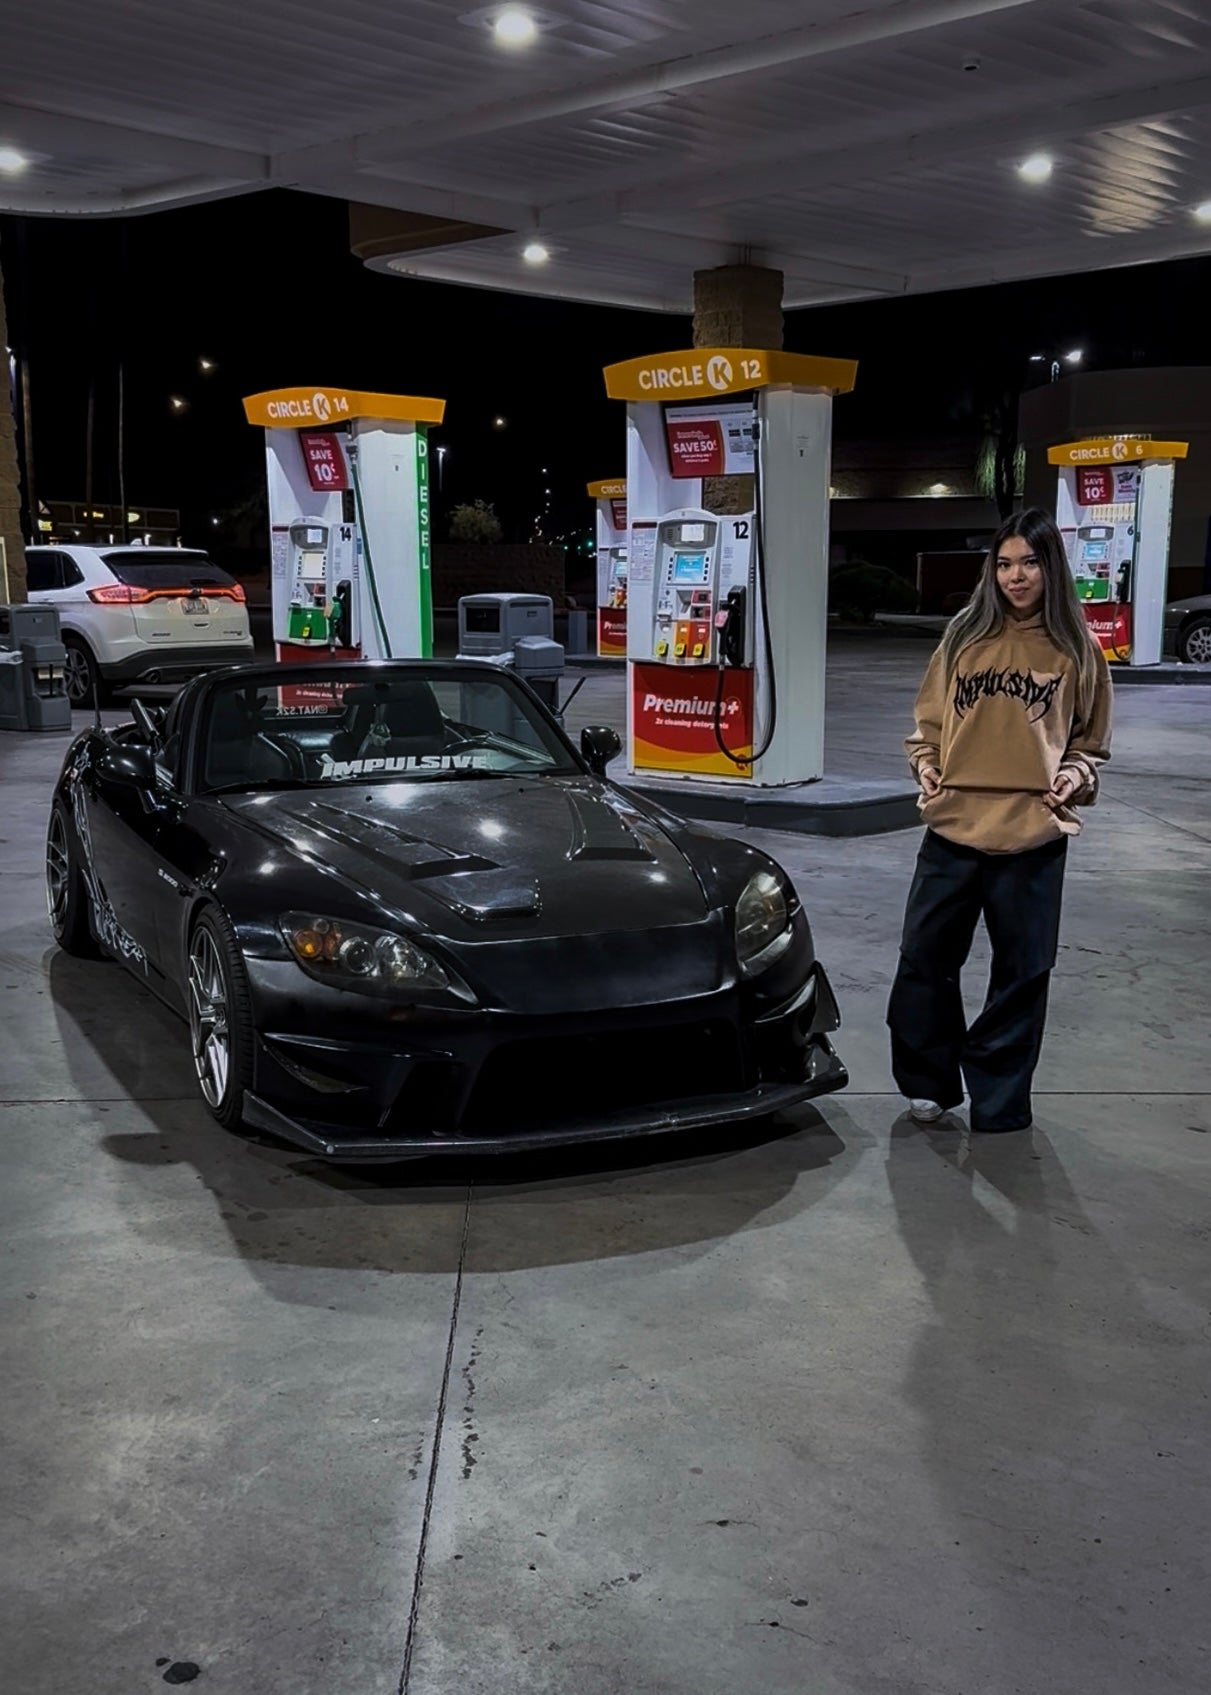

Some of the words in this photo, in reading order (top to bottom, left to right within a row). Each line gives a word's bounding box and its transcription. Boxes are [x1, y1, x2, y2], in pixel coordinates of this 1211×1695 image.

[638, 364, 703, 390] CIRCLE
[708, 357, 732, 390] K
[740, 359, 762, 380] 12
[267, 399, 313, 418] CIRCLE
[313, 394, 331, 420] K
[333, 396, 349, 413] 14
[309, 449, 333, 461] SAVE
[673, 441, 700, 454] SAVE
[1069, 447, 1110, 462] CIRCLE
[1113, 443, 1128, 460] K
[1136, 445, 1143, 455] 6
[1084, 478, 1105, 486] SAVE
[418, 439, 430, 570] DIESEL
[340, 526, 351, 542] 14
[732, 520, 749, 539] 12
[1127, 525, 1134, 536] 6
[643, 693, 739, 716] Premium+
[320, 754, 488, 780] IMPULSIVE
